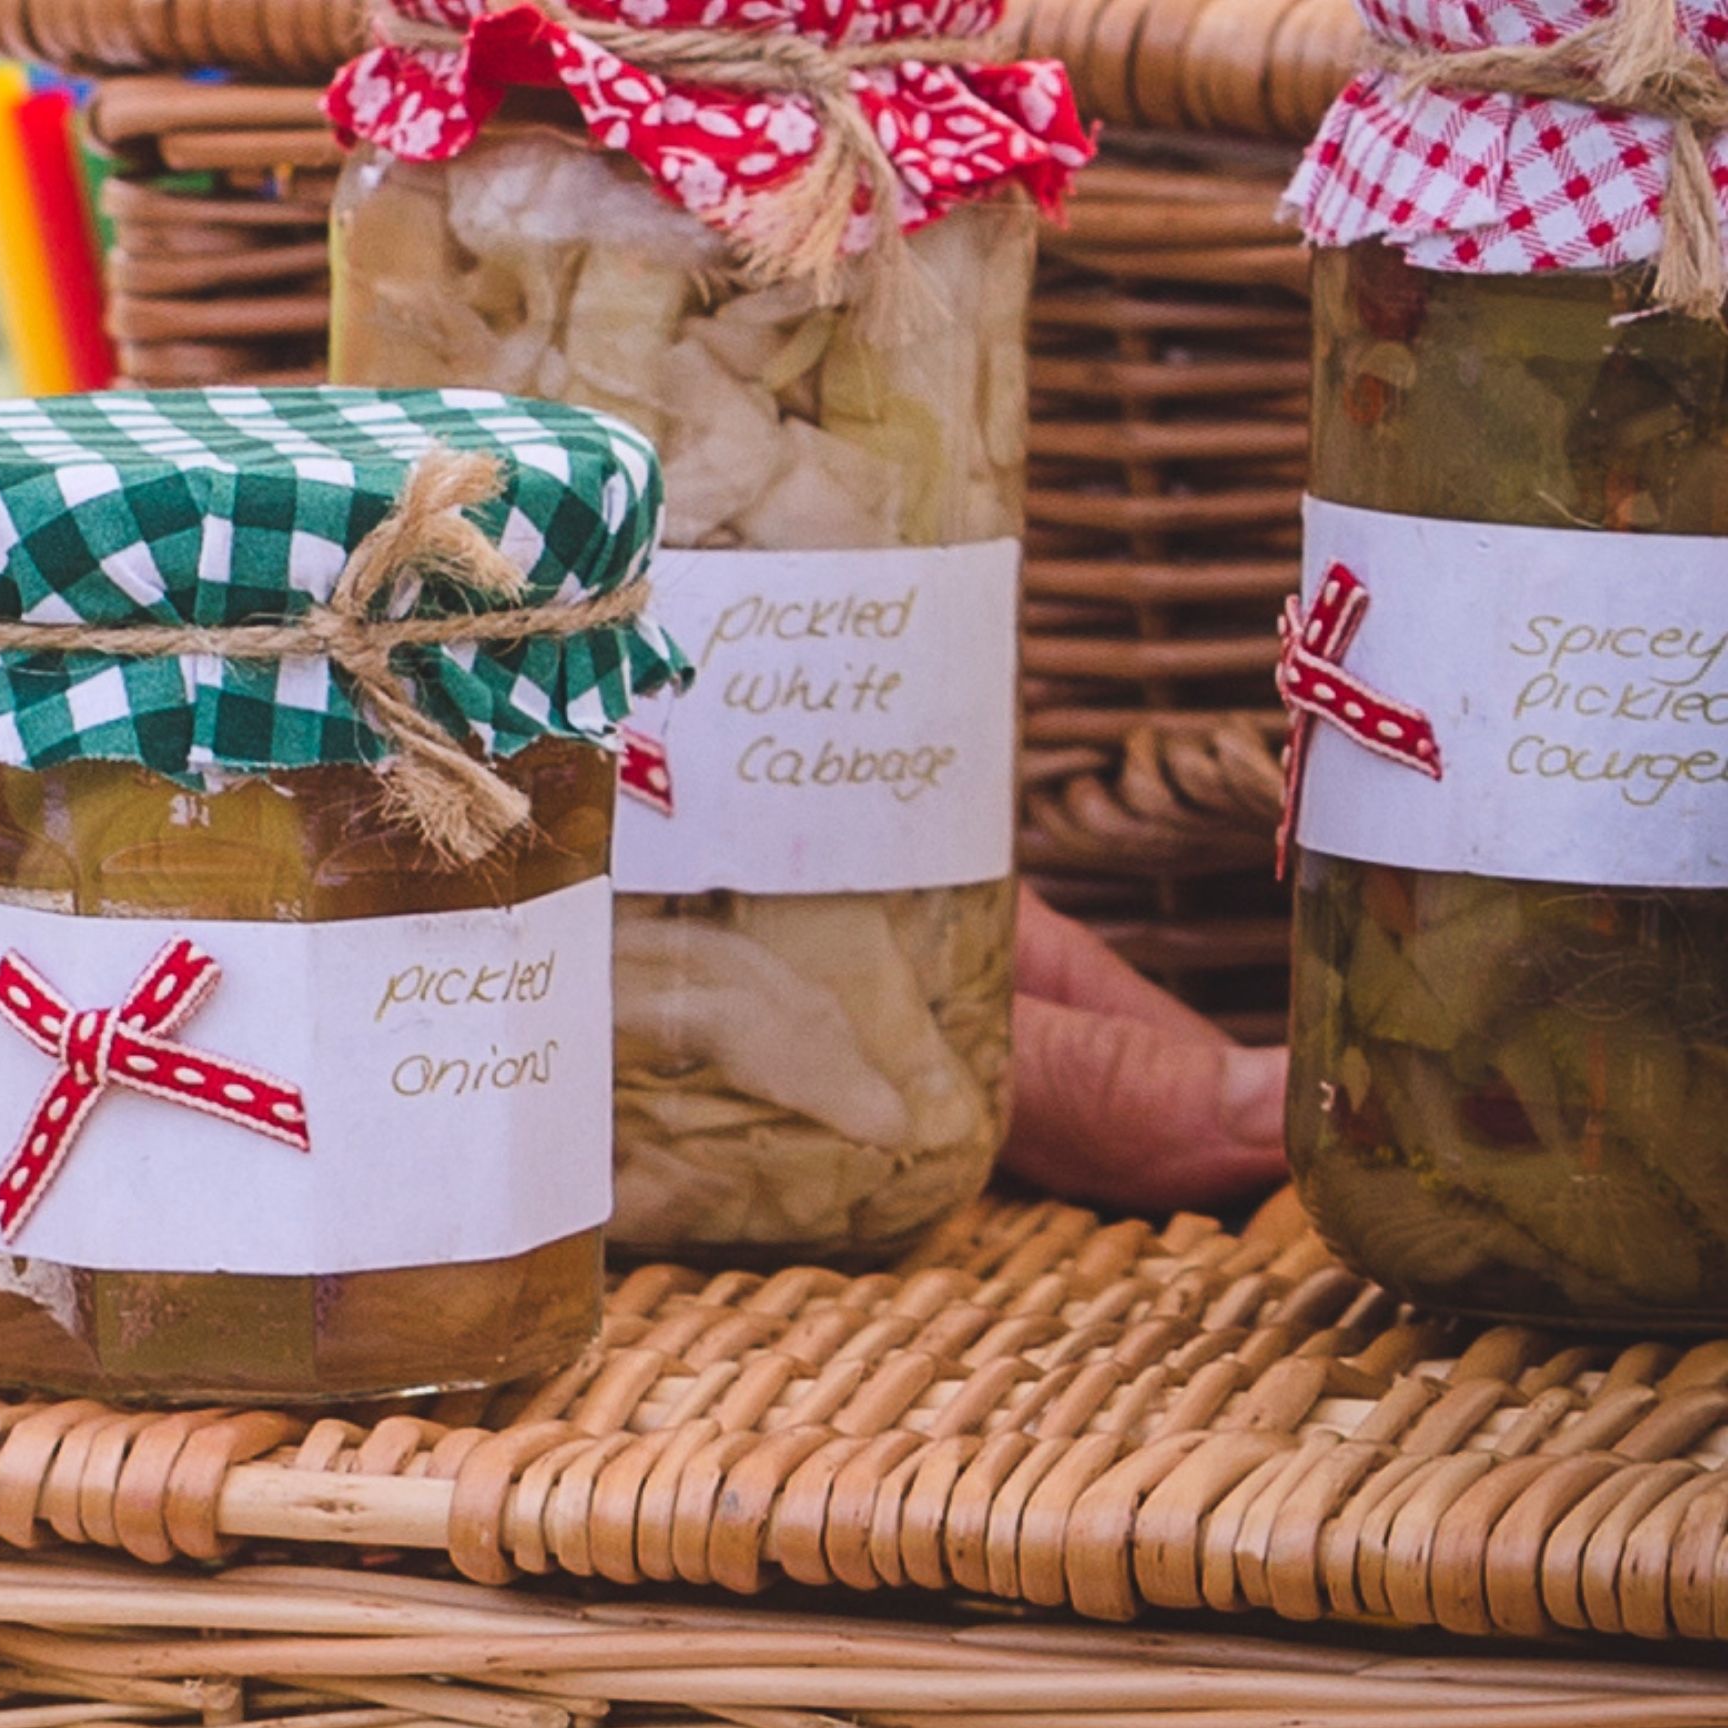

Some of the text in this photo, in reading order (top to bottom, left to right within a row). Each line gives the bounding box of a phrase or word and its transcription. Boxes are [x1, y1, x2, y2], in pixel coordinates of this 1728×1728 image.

[1508, 614, 1728, 687] Spicey
[736, 734, 958, 803] Cabbage
[1507, 734, 1728, 807] Courge
